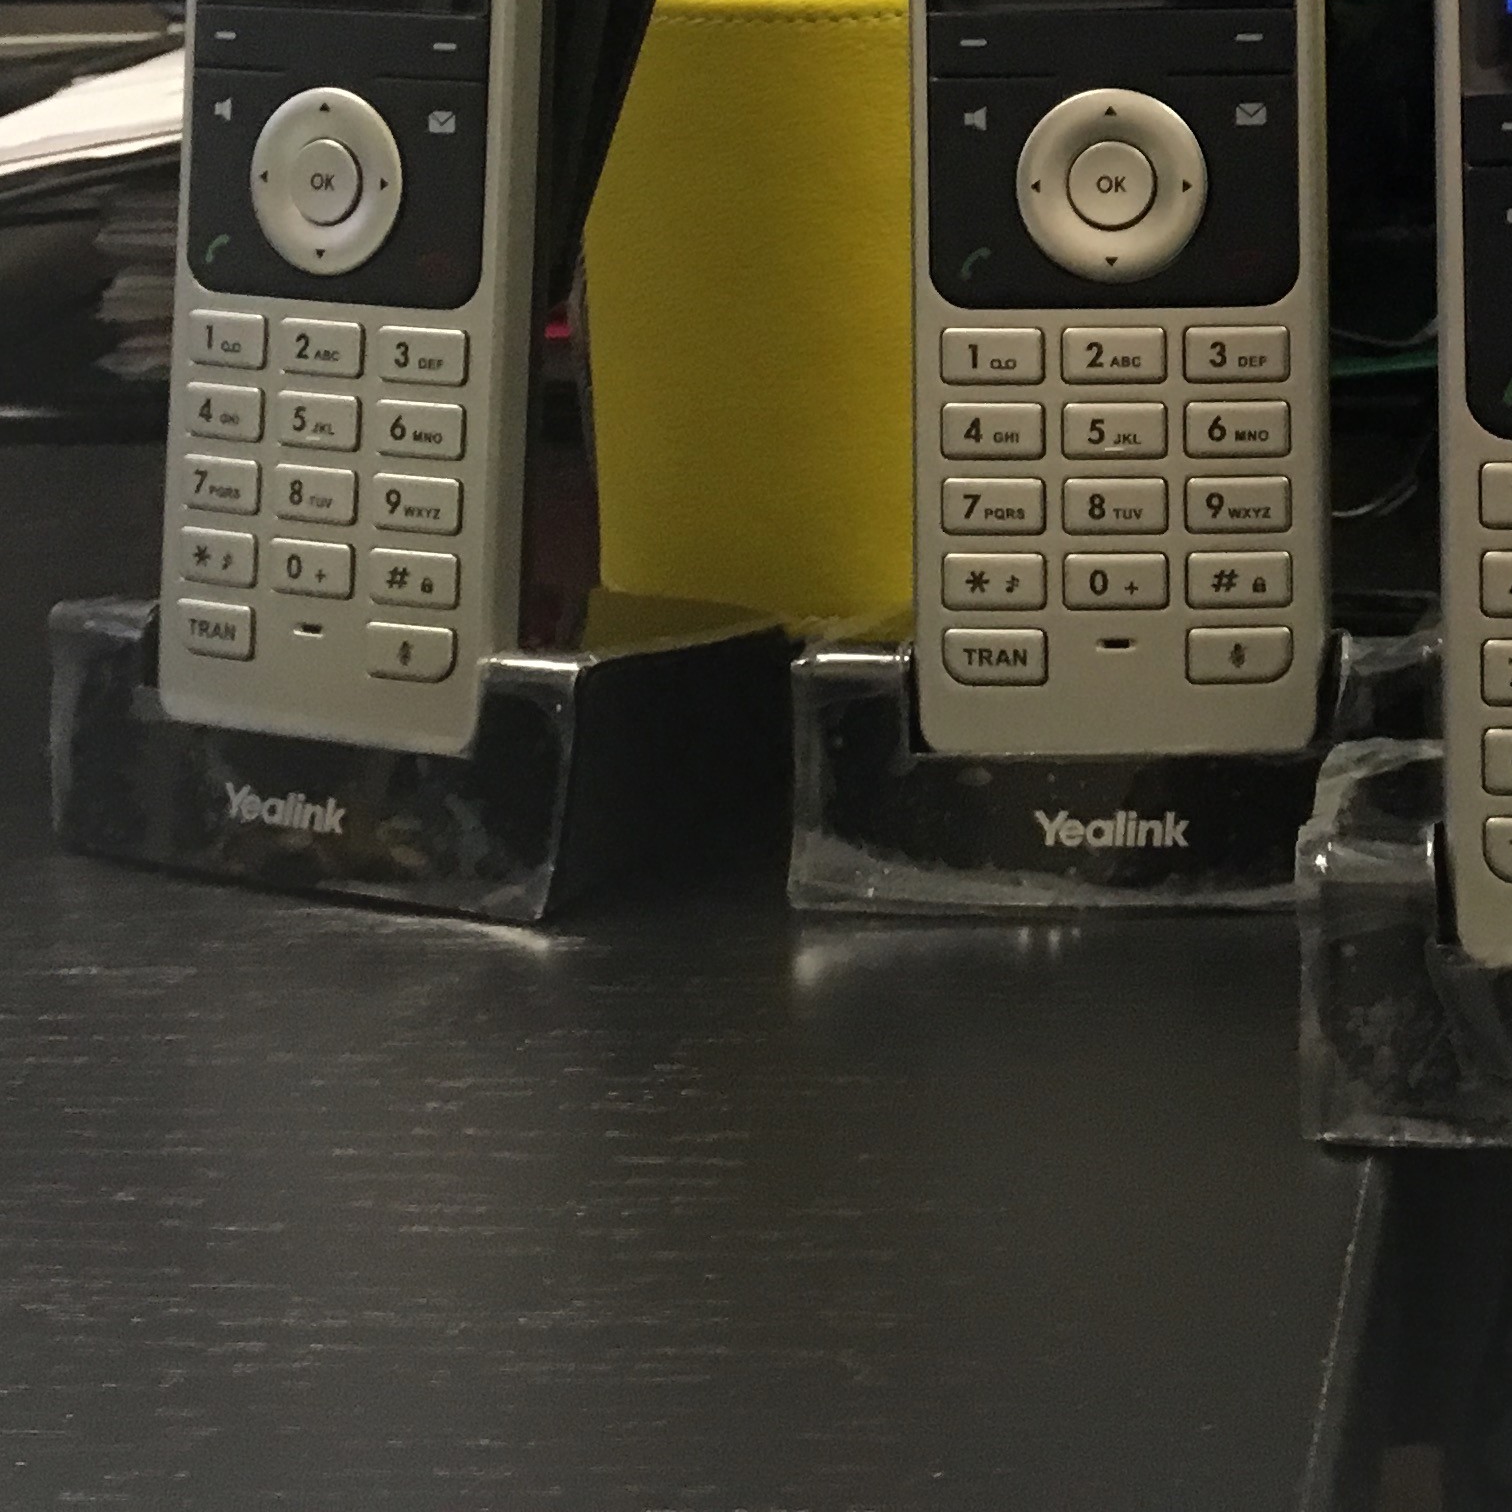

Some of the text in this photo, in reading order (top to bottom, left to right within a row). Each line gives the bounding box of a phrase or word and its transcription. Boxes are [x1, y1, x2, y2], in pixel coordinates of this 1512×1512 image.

[311, 172, 335, 192] OK
[1096, 174, 1127, 195] OK
[203, 324, 216, 351] 1
[295, 333, 311, 361] 2
[394, 342, 409, 369] 3
[966, 344, 979, 369] 1
[1086, 343, 1141, 369] 2 ABC
[1209, 342, 1266, 369] 3 DEF
[199, 398, 213, 425] 4
[292, 407, 307, 434] 5
[390, 415, 406, 442] 6
[963, 419, 1020, 444] 4 GHI
[1088, 420, 1141, 445] 5 JKL
[1208, 417, 1269, 444] 6 MNO
[193, 470, 207, 497] 7
[289, 480, 304, 506] 8
[385, 489, 402, 517] 9
[963, 495, 1025, 520] 7 PQRS
[1088, 495, 1143, 520] 8 TUV
[1206, 493, 1271, 520] 9 WXYZ
[286, 555, 303, 582] 0
[1089, 570, 1108, 597] 0
[189, 618, 236, 644] TRAN
[963, 647, 1028, 669] TRAN
[224, 784, 344, 835] Yealink
[1035, 810, 1189, 850] Yealink
